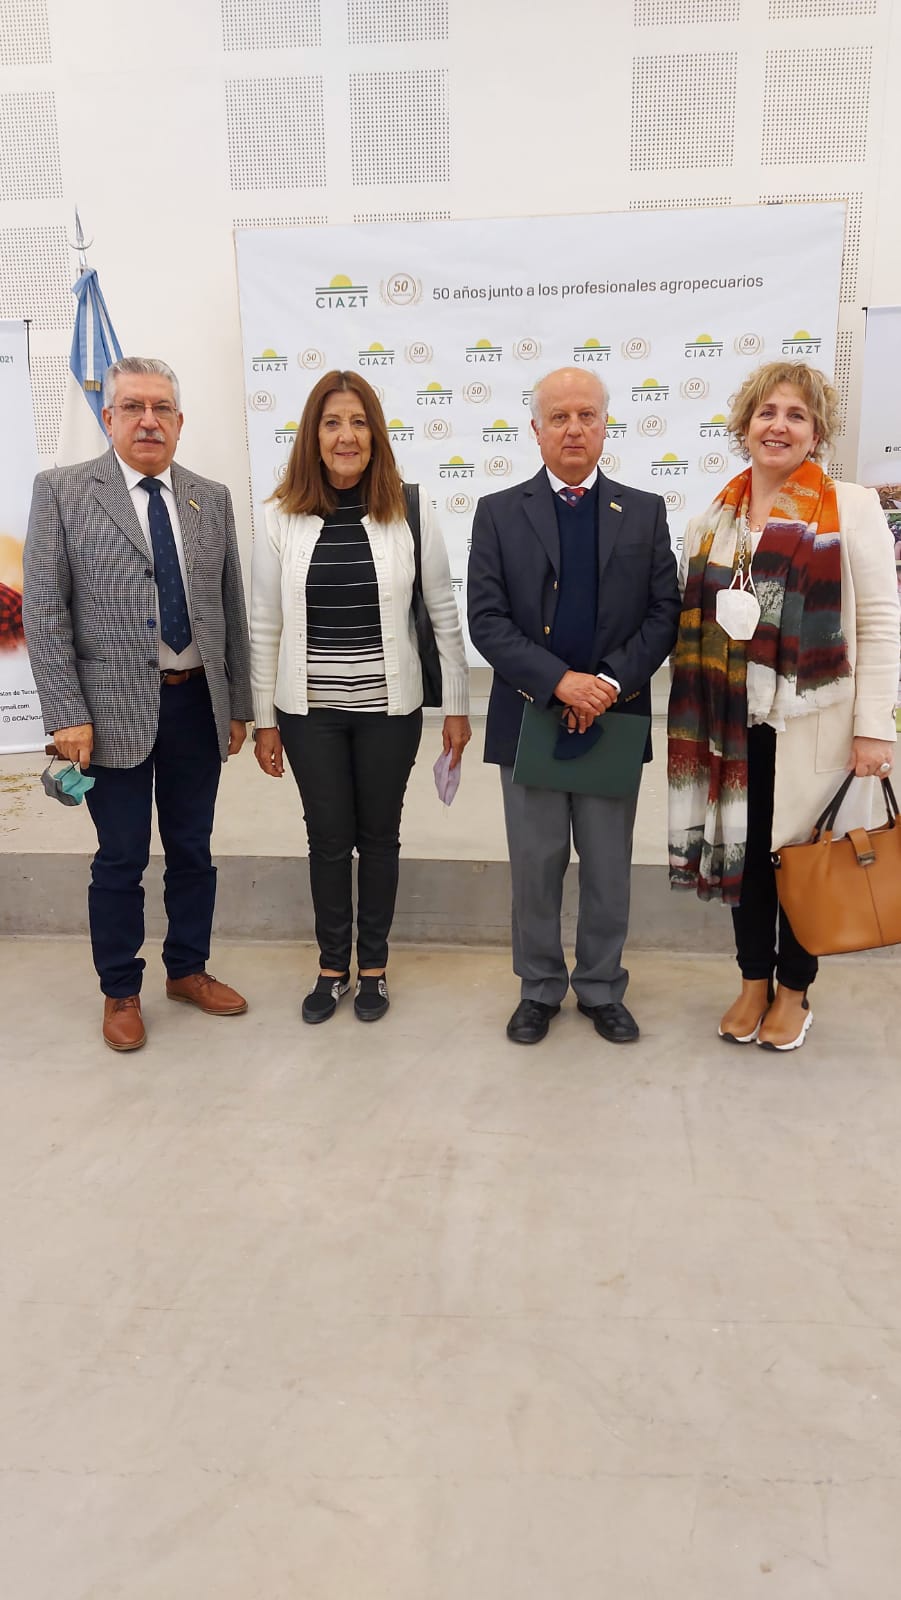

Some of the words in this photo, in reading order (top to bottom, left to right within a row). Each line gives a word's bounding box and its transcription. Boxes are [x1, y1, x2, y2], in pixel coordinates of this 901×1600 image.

[393, 280, 408, 292] 50
[432, 288, 450, 300] 50
[453, 286, 486, 299] años
[488, 284, 523, 301] junto
[526, 287, 535, 297] a
[538, 284, 558, 296] los
[562, 279, 656, 299] profesionales
[660, 274, 764, 294] agropecuarios
[316, 296, 368, 309] CIAZT
[522, 343, 532, 352] 50
[630, 342, 642, 351] 50
[744, 338, 755, 348] 50
[413, 346, 424, 356] 50
[684, 348, 724, 358] CIAZT
[782, 344, 822, 355] CIAZT
[306, 353, 317, 362] 50
[358, 356, 395, 366] CIAZT
[466, 354, 502, 363] CIAZT
[574, 352, 611, 362] CIAZT
[252, 363, 288, 372] CIAZT
[472, 386, 482, 396] 50
[689, 382, 700, 392] 50
[256, 394, 267, 404] 50
[416, 396, 453, 406] CIAZT
[632, 392, 670, 402] CIAZT
[432, 423, 444, 432] 50
[646, 420, 658, 429] 50
[392, 432, 414, 442] AZT
[482, 433, 518, 442] CIAZT
[606, 430, 628, 439] AZT
[700, 428, 729, 438] CIAZ
[275, 436, 294, 444] CIA
[493, 460, 504, 469] 50
[600, 456, 611, 466] 50
[708, 456, 720, 466] 50
[440, 470, 475, 479] CIAZT
[651, 466, 688, 476] CIAZT
[455, 497, 466, 506] 50
[666, 494, 677, 504] 50
